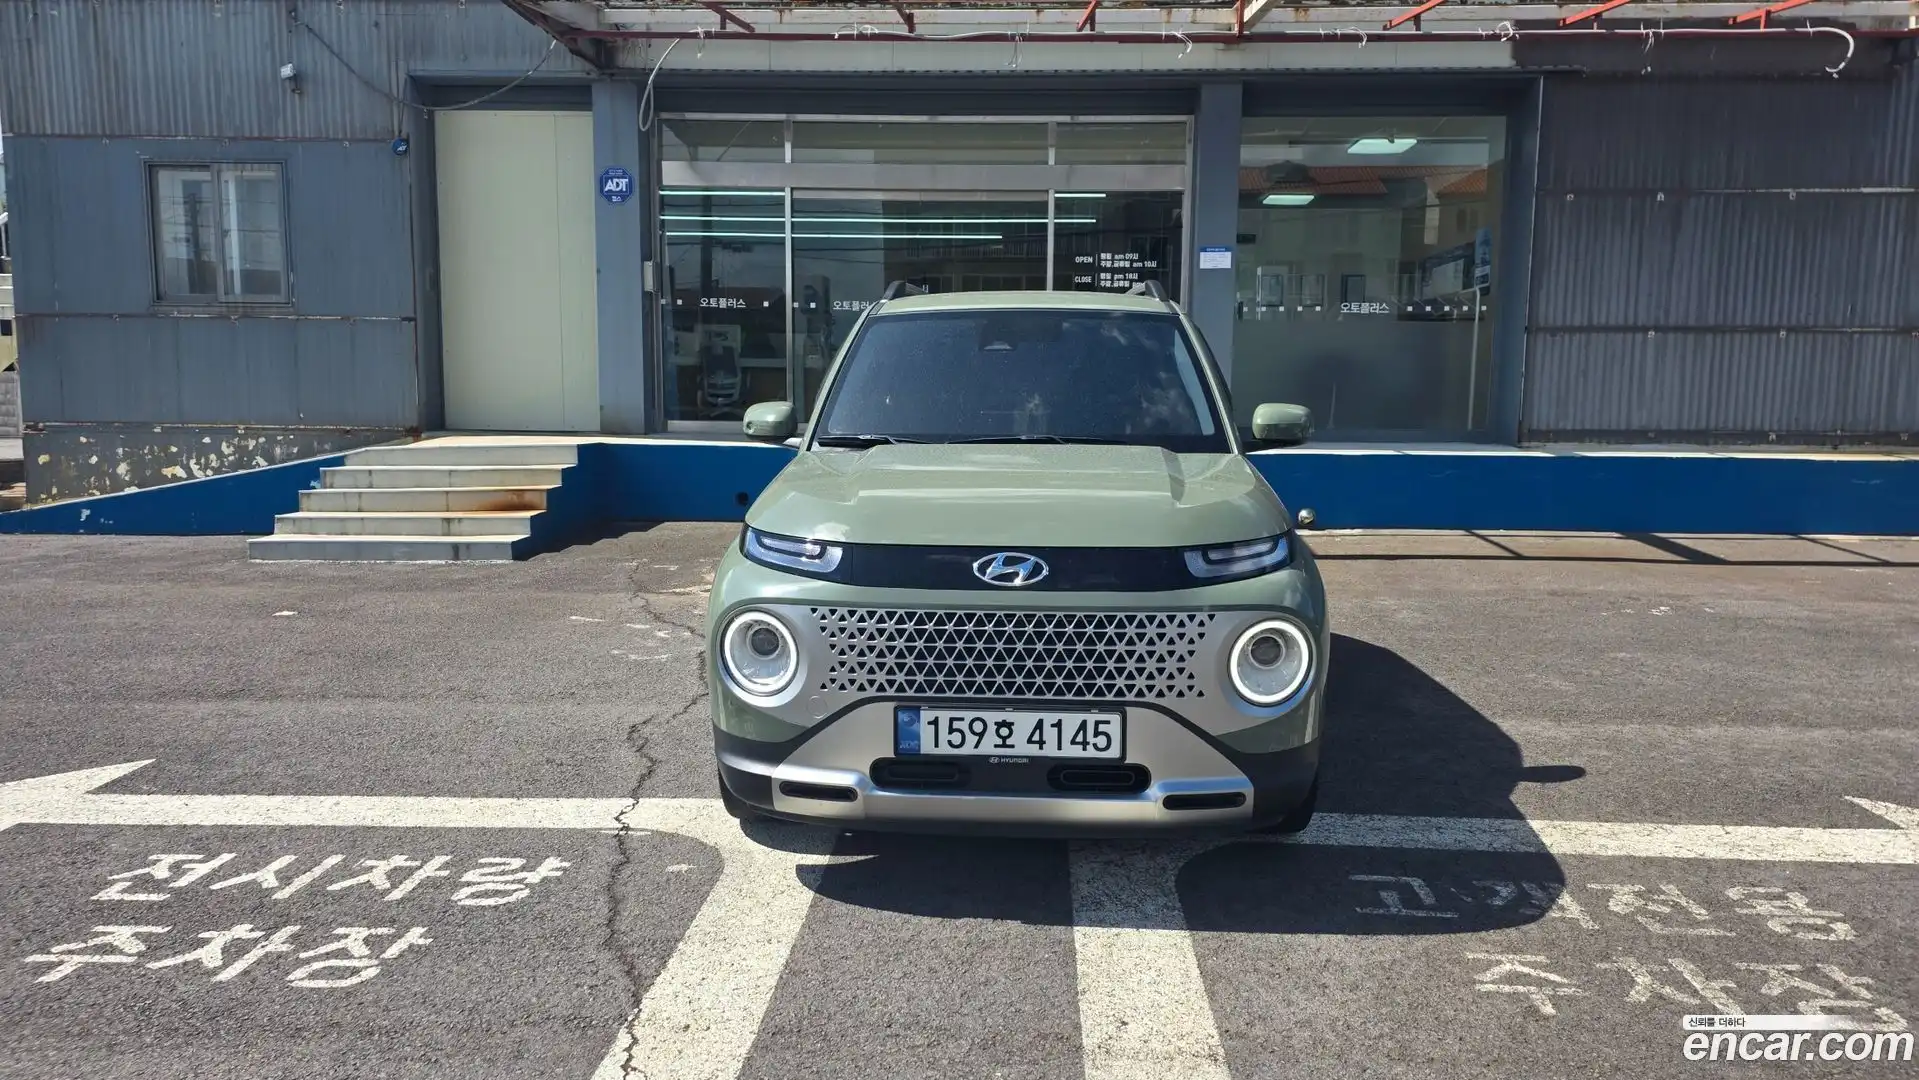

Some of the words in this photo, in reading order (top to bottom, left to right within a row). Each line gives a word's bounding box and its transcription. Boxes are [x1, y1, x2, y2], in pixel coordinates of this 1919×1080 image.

[604, 178, 629, 191] ADT
[700, 298, 746, 309] 오토플러스
[832, 300, 873, 311] 오토플러
[1340, 302, 1389, 314] 오토플러스
[927, 716, 1015, 750] 159호
[1026, 718, 1112, 752] 4145
[90, 852, 571, 907] 전시차량
[24, 922, 434, 989] 주차장
